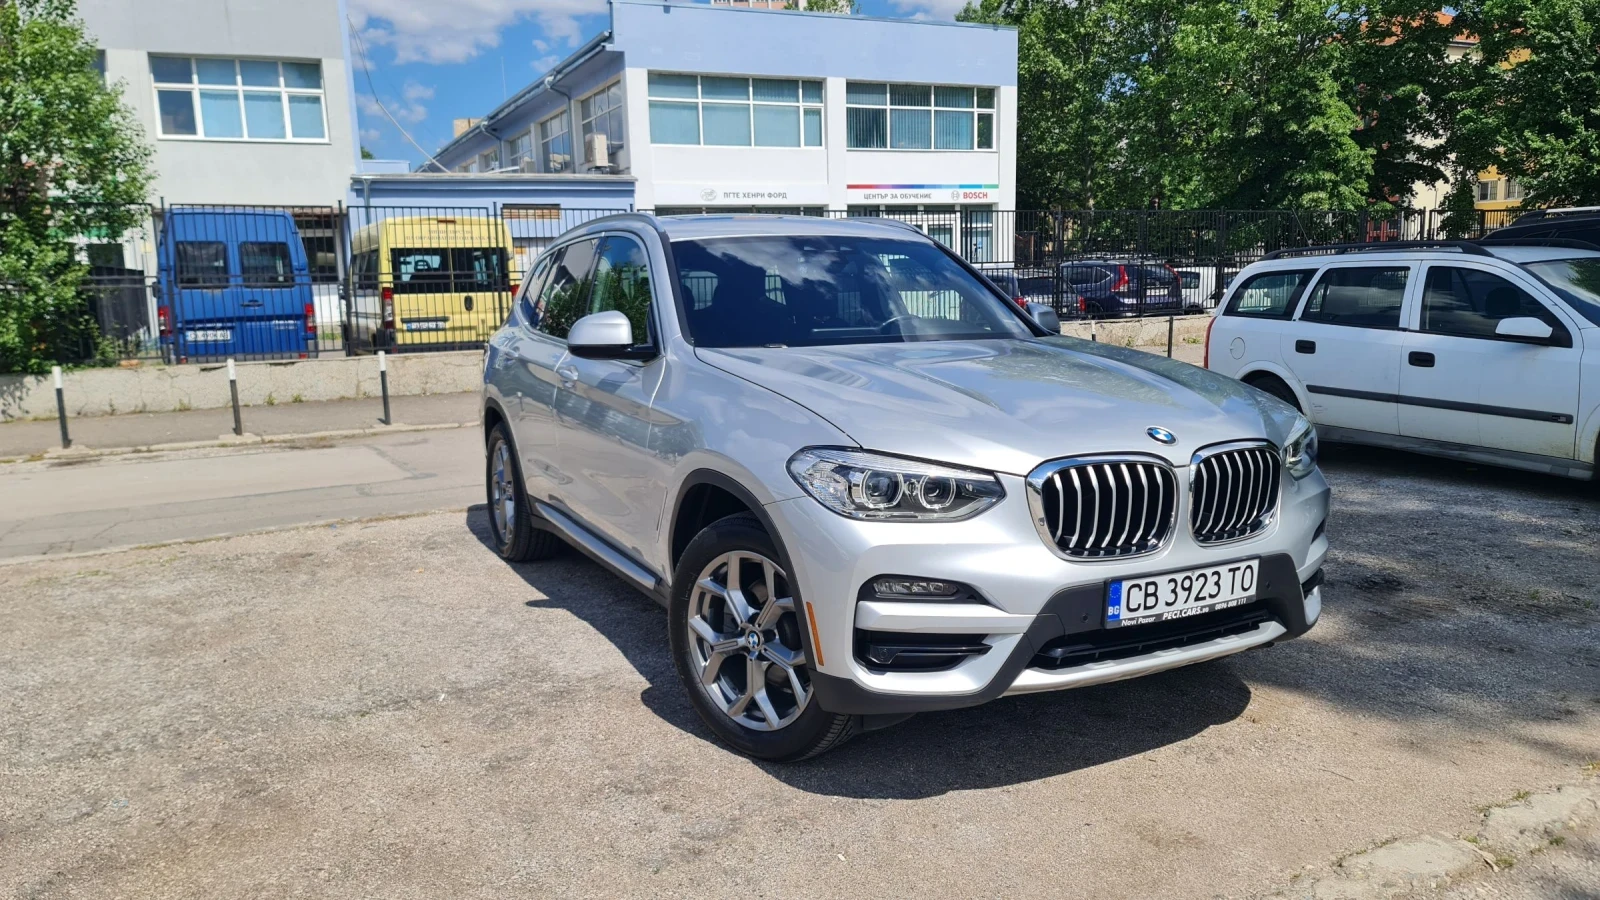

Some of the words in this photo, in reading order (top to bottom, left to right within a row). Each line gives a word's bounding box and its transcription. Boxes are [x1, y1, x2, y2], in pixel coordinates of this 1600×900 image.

[1126, 581, 1159, 612] CB
[1164, 570, 1222, 606] 3923
[1228, 564, 1254, 595] TO
[1108, 606, 1120, 616] BG
[1122, 618, 1137, 626] Novi
[1138, 616, 1156, 624] Pazar
